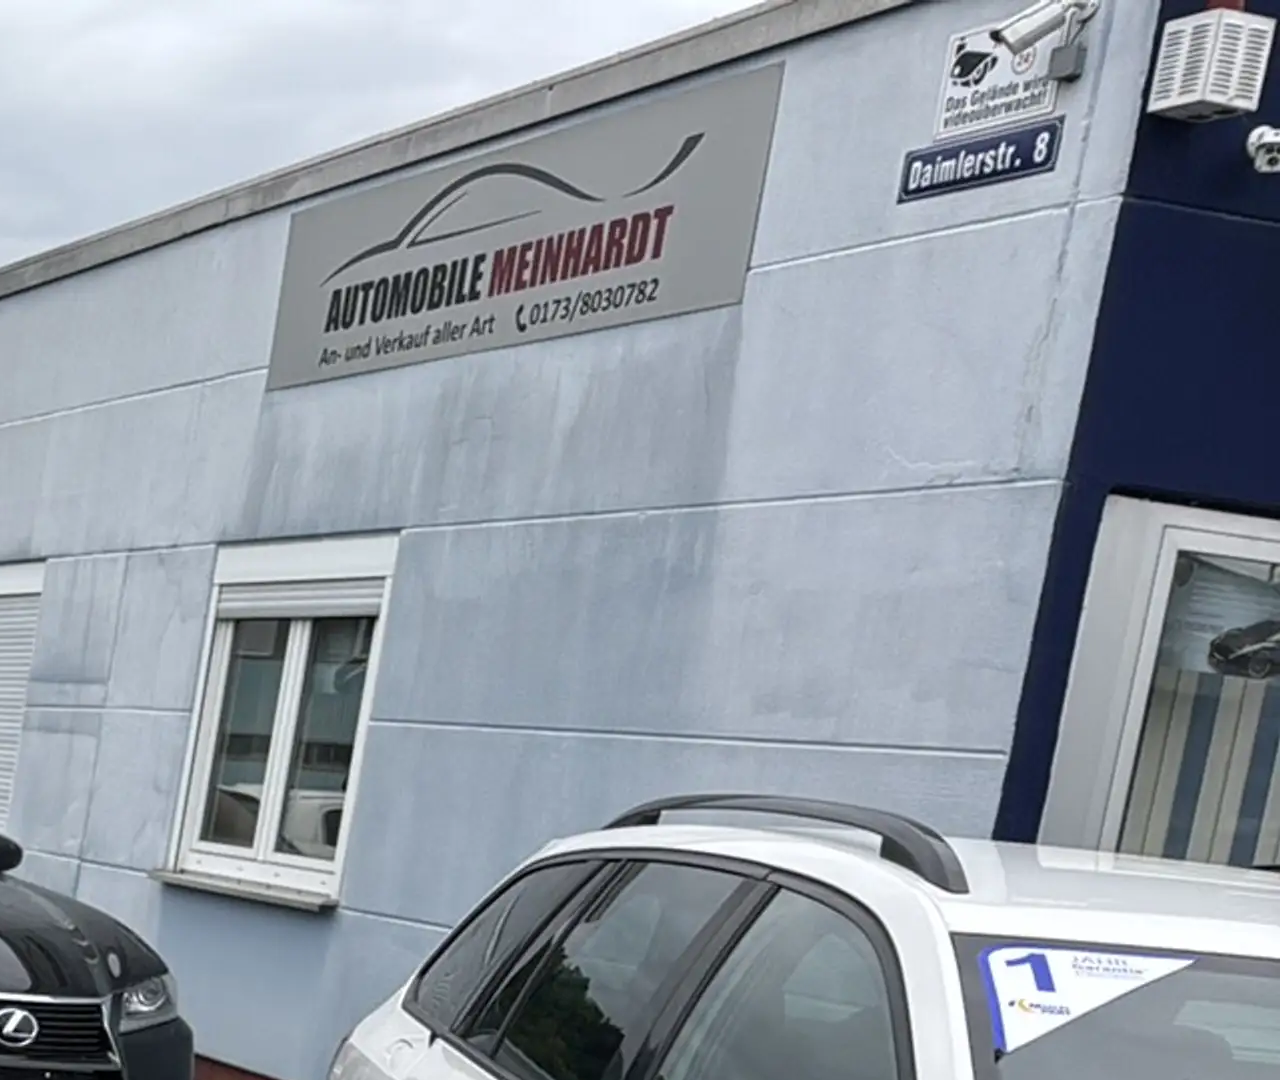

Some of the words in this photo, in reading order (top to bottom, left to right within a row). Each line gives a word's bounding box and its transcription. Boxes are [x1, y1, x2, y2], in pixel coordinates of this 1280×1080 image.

[908, 142, 1021, 190] Daimlerstr.
[1033, 132, 1049, 162] 8
[324, 253, 486, 333] AUTOMOBILE
[488, 205, 674, 298] MEINHARDT
[530, 278, 658, 325] 0173/8030782
[319, 348, 341, 367] An-
[345, 335, 370, 360] und
[375, 325, 432, 357] Verkauf
[433, 319, 466, 341] aller
[470, 315, 495, 336] Art
[1005, 953, 1056, 992] 1
